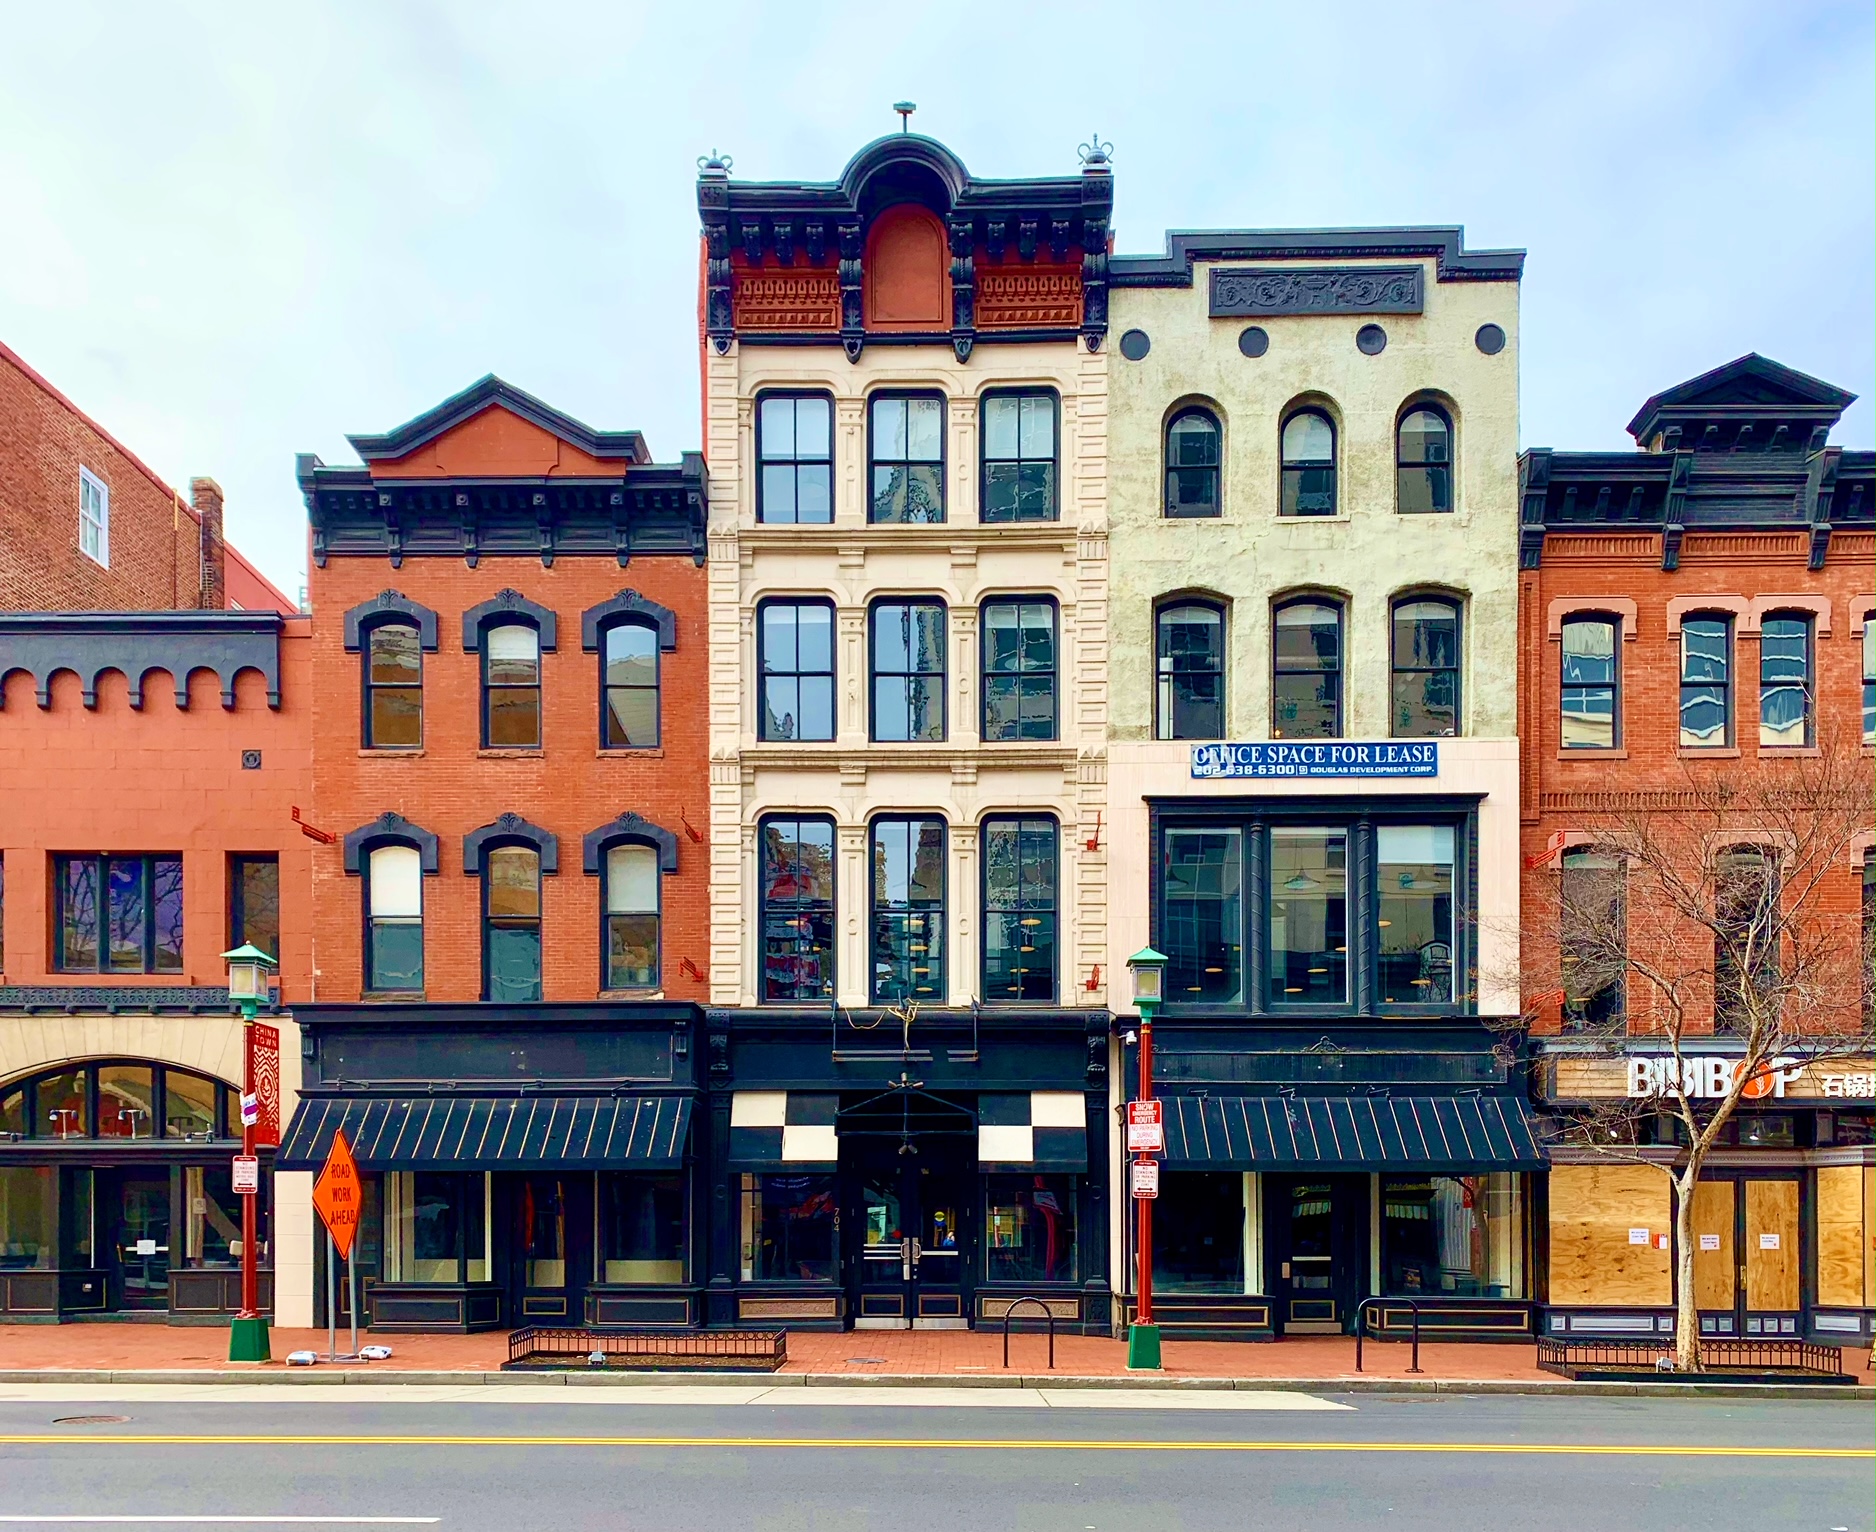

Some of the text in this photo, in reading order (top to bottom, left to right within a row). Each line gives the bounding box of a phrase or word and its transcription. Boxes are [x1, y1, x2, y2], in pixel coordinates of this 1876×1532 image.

[1194, 745, 1435, 764] OFFICE SPACE FOR LEASE
[1193, 765, 1295, 775] 202-638-6300
[1410, 765, 1435, 773] CORP.
[255, 1025, 277, 1039] CHINA
[255, 1034, 277, 1048] TOWN
[1135, 1103, 1155, 1111] SNOW
[1134, 1116, 1155, 1124] ROUTE
[331, 1164, 351, 1179] ROAD
[331, 1187, 352, 1202] WORK
[330, 1210, 356, 1226] AHEAD
